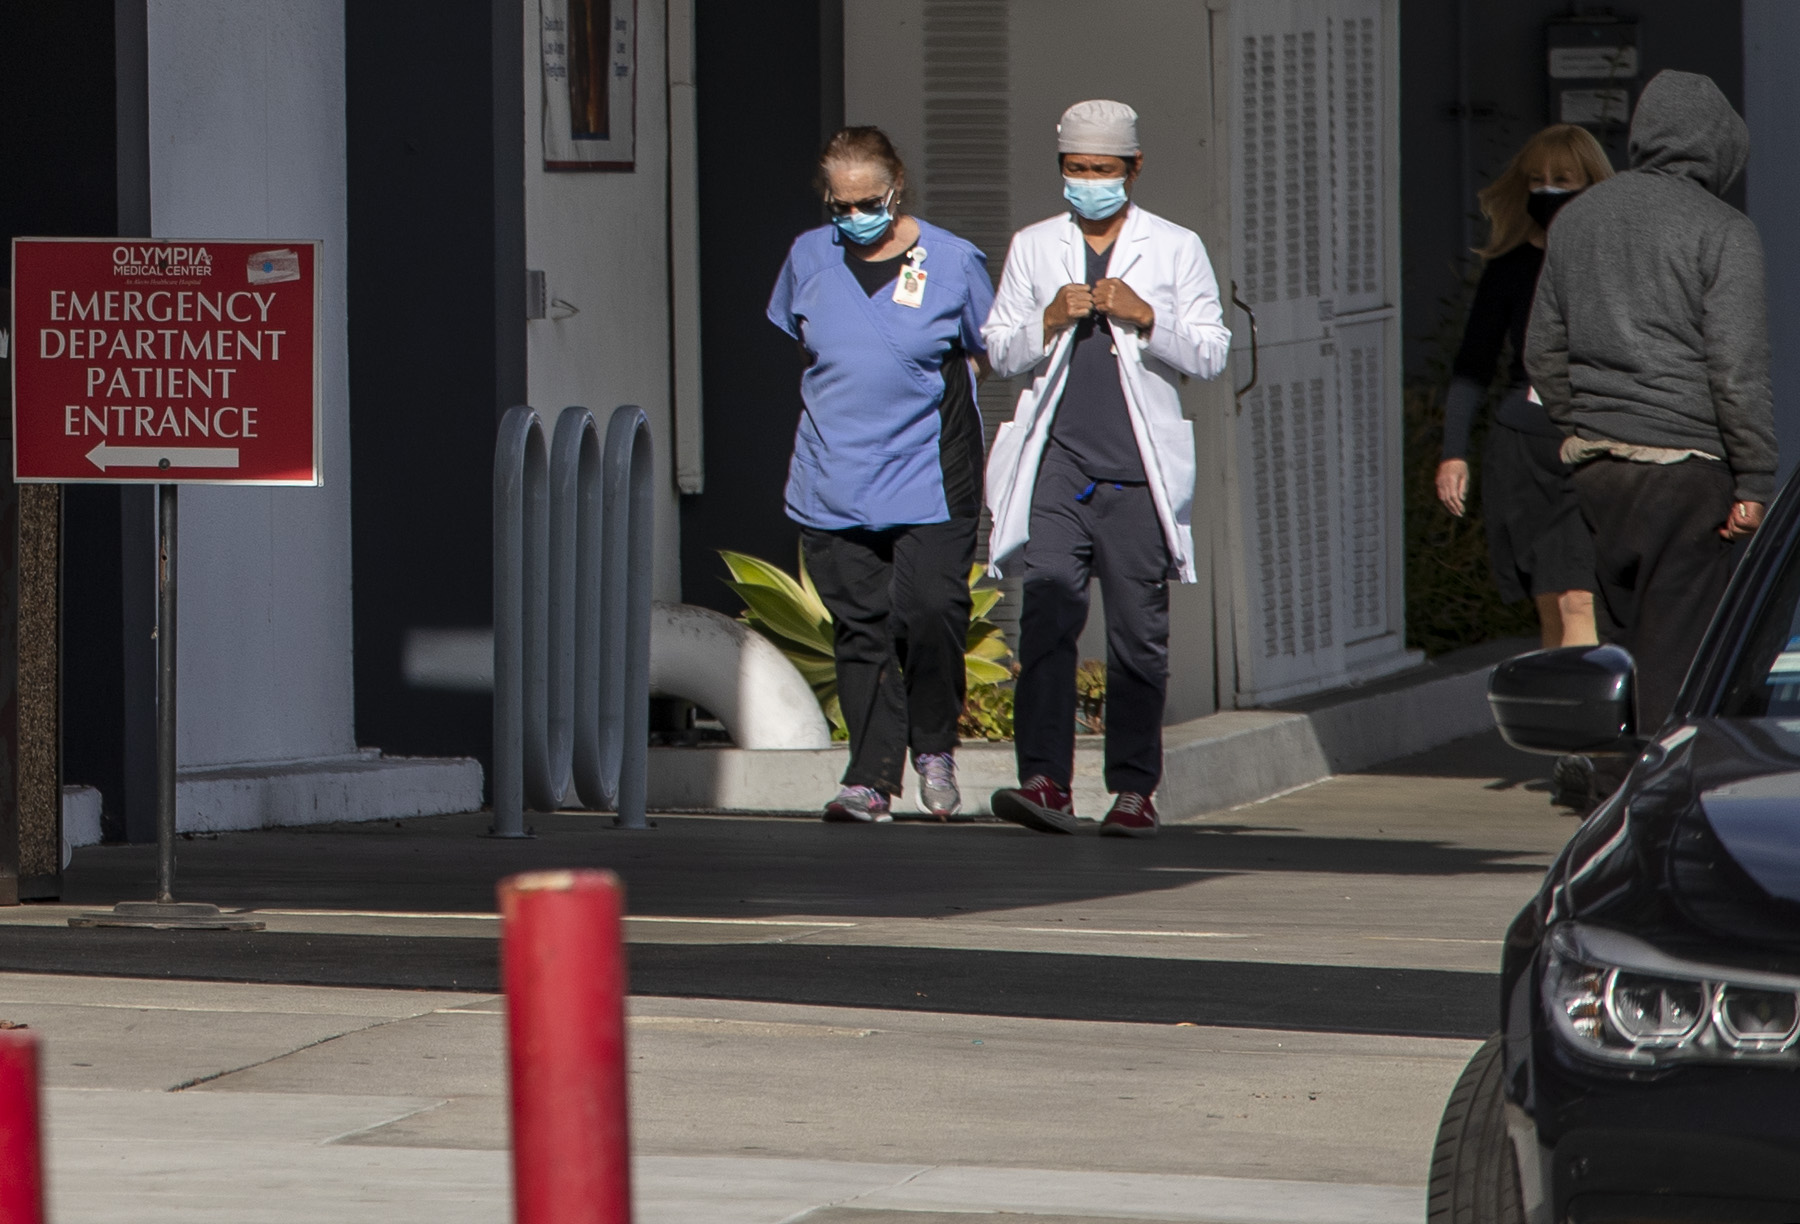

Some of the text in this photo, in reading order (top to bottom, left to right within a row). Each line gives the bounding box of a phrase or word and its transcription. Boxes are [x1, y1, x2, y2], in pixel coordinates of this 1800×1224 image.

[112, 246, 212, 265] OLYMPIA
[114, 266, 212, 276] MEDICAL CENTER
[50, 290, 277, 323] EMERGENCY
[40, 329, 286, 361] DEPARTMENT
[86, 367, 237, 399] PATIENT
[64, 405, 259, 438] ENTRANCE
